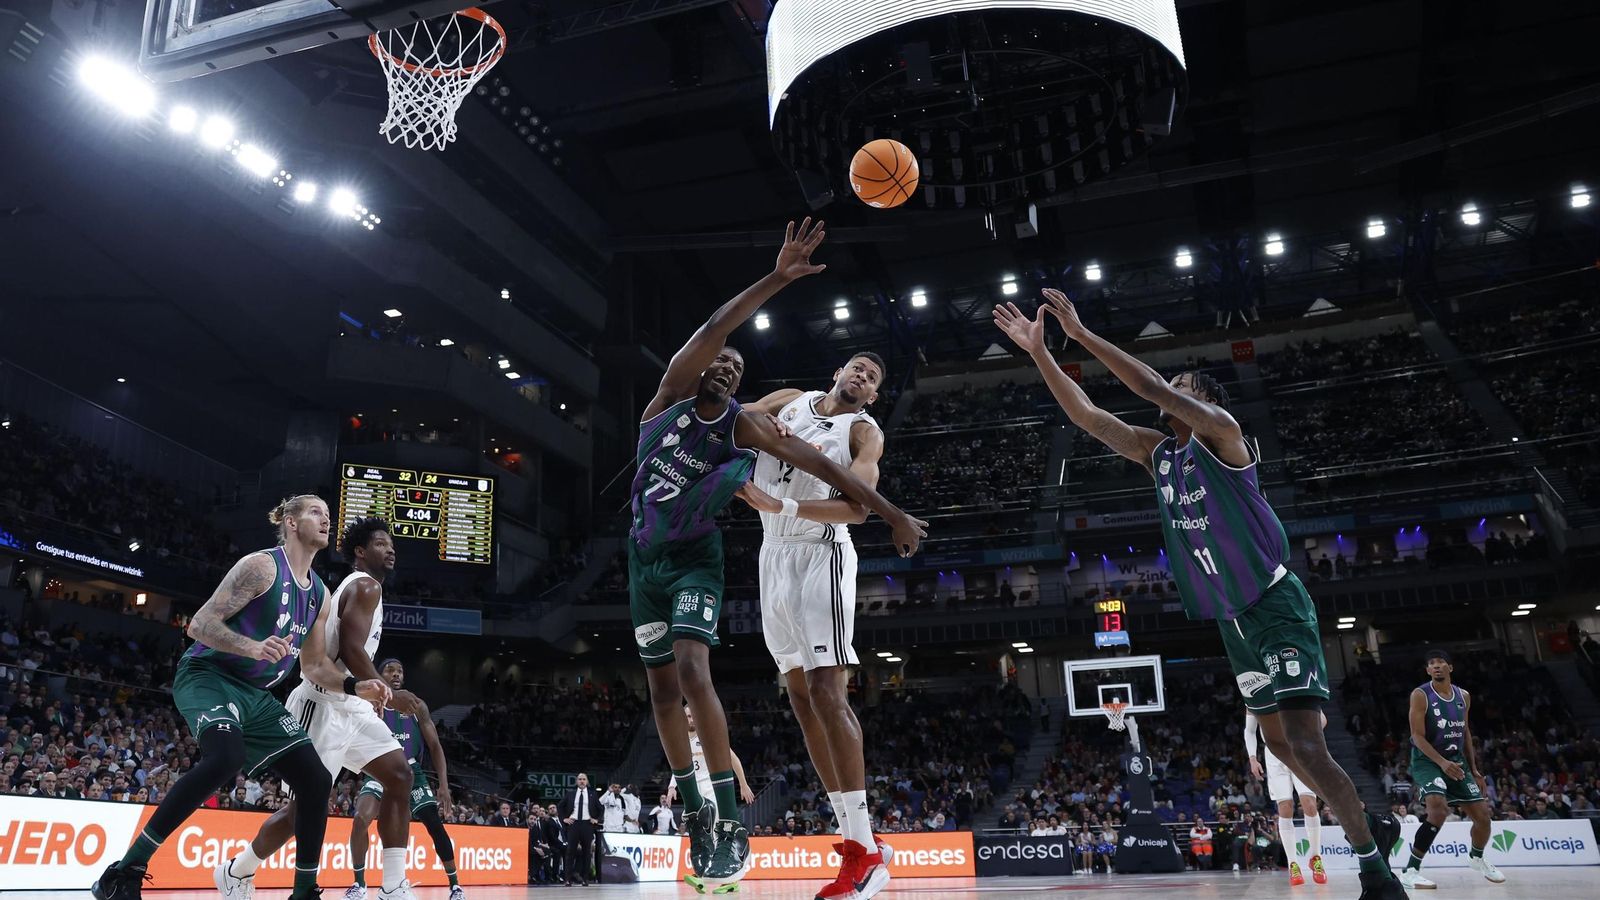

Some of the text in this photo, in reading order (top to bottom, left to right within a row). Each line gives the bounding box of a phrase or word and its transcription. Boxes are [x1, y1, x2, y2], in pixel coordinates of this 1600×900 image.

[673, 446, 712, 474] Unicaja
[399, 471, 412, 482] 32
[424, 474, 438, 484] 24
[651, 456, 689, 487] málag
[414, 491, 422, 500] 2
[645, 473, 681, 502] 77
[406, 508, 431, 521] 4:04
[422, 528, 430, 537] 2
[36, 541, 65, 556] Consigue
[65, 548, 75, 560] tus
[75, 552, 100, 566] entradas
[100, 560, 108, 568] en
[1194, 546, 1218, 575] 11
[1100, 600, 1120, 612] 4:03
[1106, 614, 1120, 632] 13
[528, 774, 577, 788] SALID
[978, 840, 1064, 860] endesa
[1138, 839, 1168, 848] Unicaja
[1522, 836, 1585, 854] Unicaja
[460, 846, 512, 870] meses
[894, 848, 966, 866] meses
